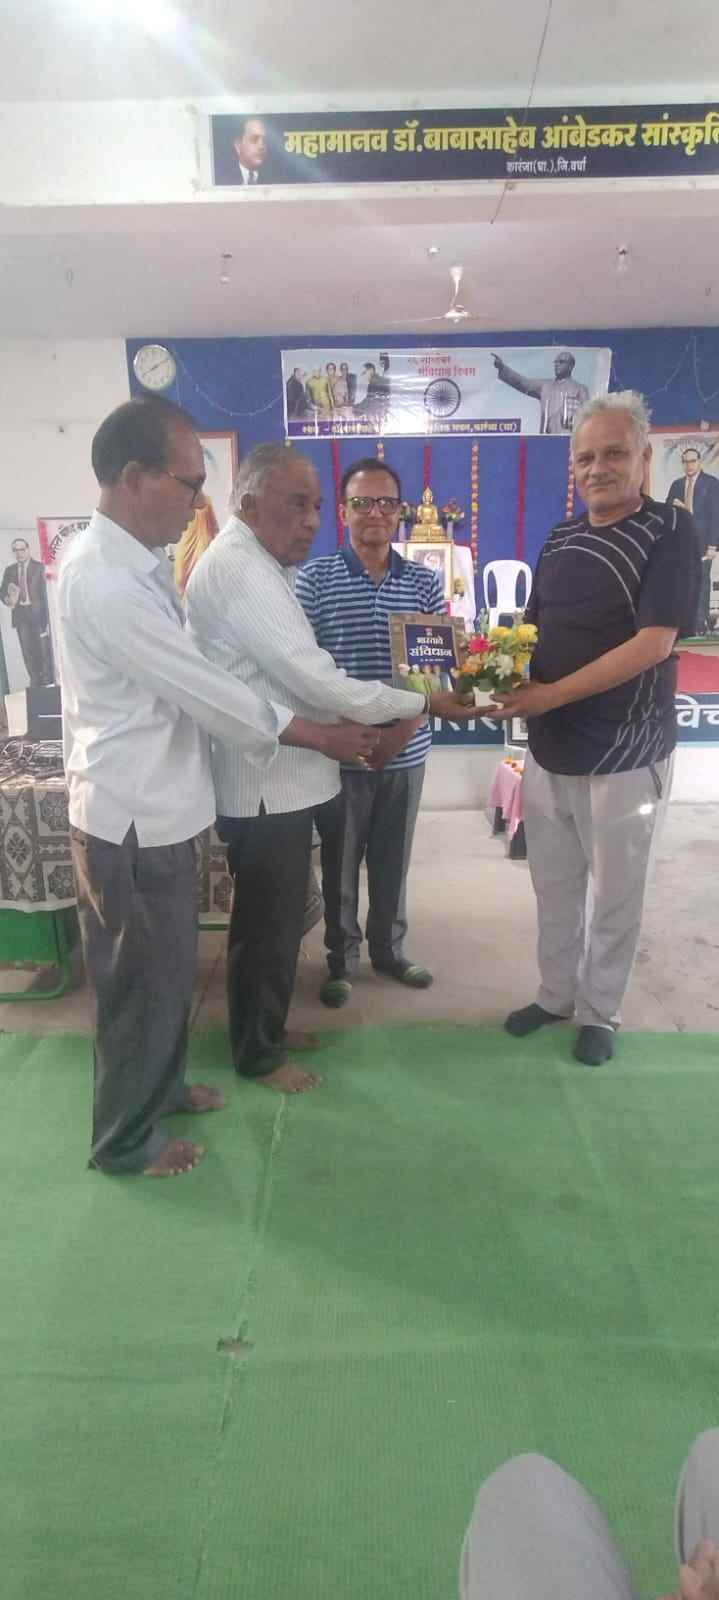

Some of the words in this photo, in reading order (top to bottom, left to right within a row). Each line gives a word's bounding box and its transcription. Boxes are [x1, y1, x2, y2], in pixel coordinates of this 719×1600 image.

[284, 128, 388, 160] महामानव
[541, 113, 638, 149] आंबेडकर
[408, 645, 453, 657] संविधान
